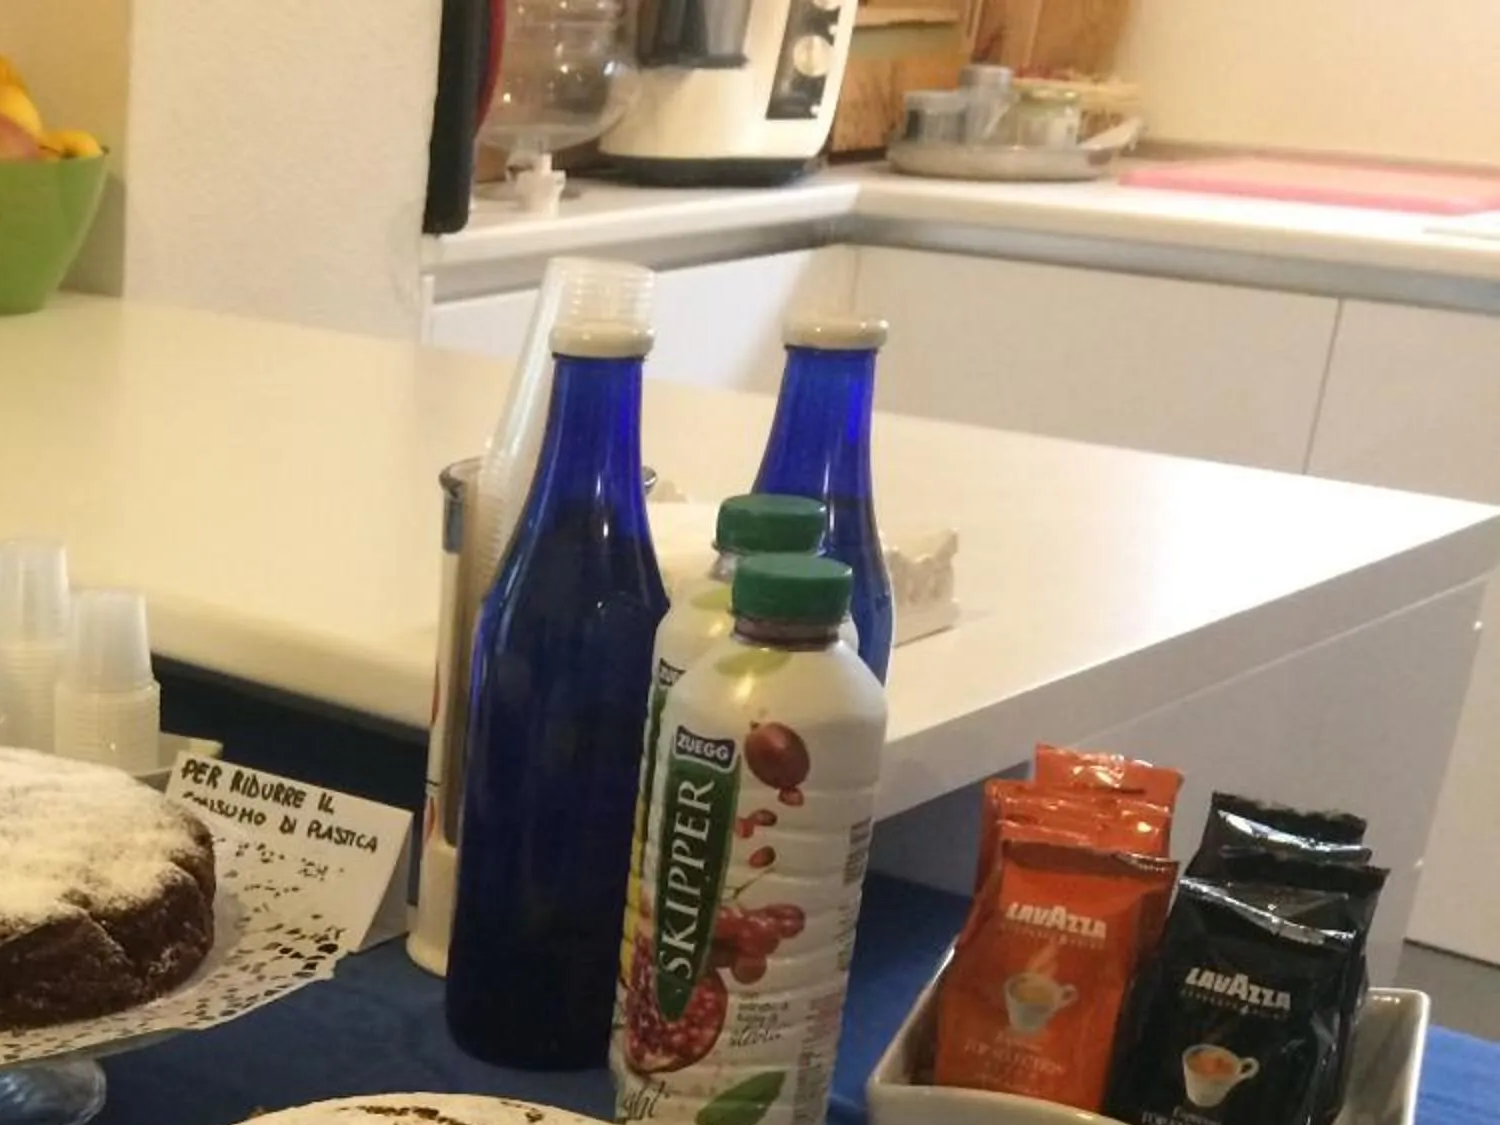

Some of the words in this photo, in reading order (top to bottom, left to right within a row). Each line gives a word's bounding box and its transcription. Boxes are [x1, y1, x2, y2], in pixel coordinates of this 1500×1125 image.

[676, 732, 730, 761] ZUEGG
[181, 758, 222, 789] PER
[229, 769, 307, 809] RIDURRE
[318, 791, 336, 815] IL
[279, 814, 298, 836] DI
[306, 818, 379, 854] PLASTICA
[659, 778, 716, 980] SKIPPER
[1004, 901, 1107, 939] LAVAZZA
[1184, 967, 1291, 1012] LAVAZZA
